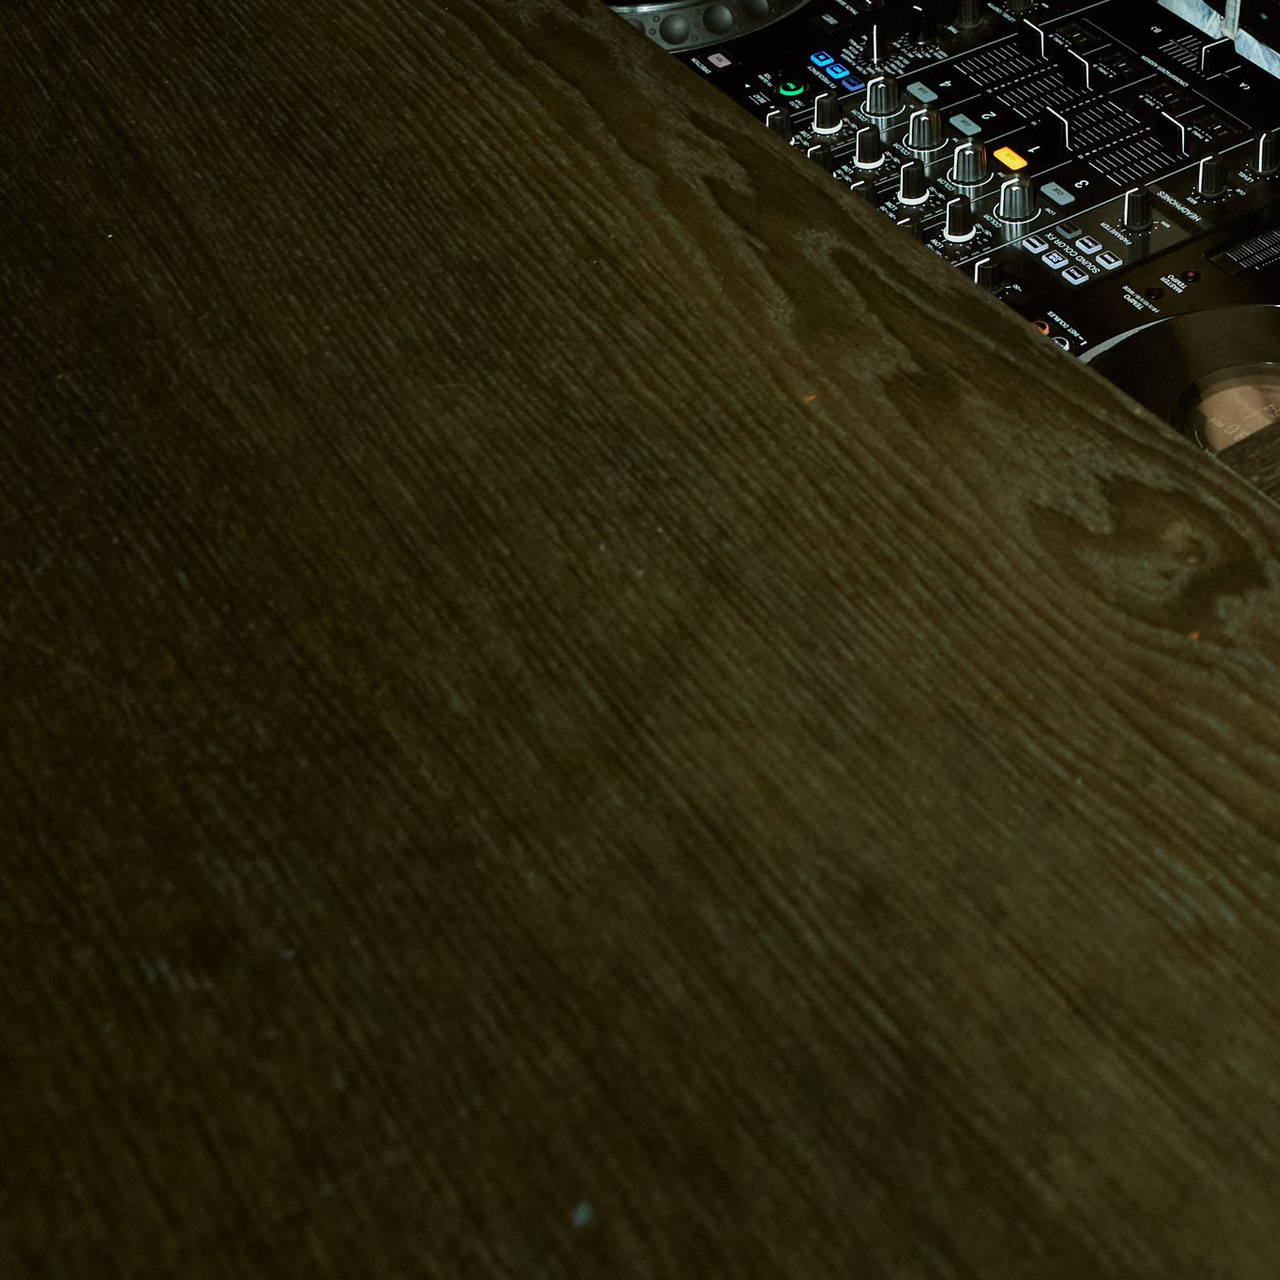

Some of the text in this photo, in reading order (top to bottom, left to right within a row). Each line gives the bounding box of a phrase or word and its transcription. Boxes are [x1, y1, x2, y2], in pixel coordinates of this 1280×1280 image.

[981, 111, 997, 120] 2
[1074, 180, 1089, 188] 3
[1157, 191, 1202, 222] HEADPHONES
[1100, 222, 1132, 245] PARAMETER
[1045, 232, 1100, 274] SOUND COLOR FX
[1160, 276, 1185, 294] MASTER
[1165, 274, 1187, 289] TEMPO
[1123, 294, 1146, 310] TEMPO
